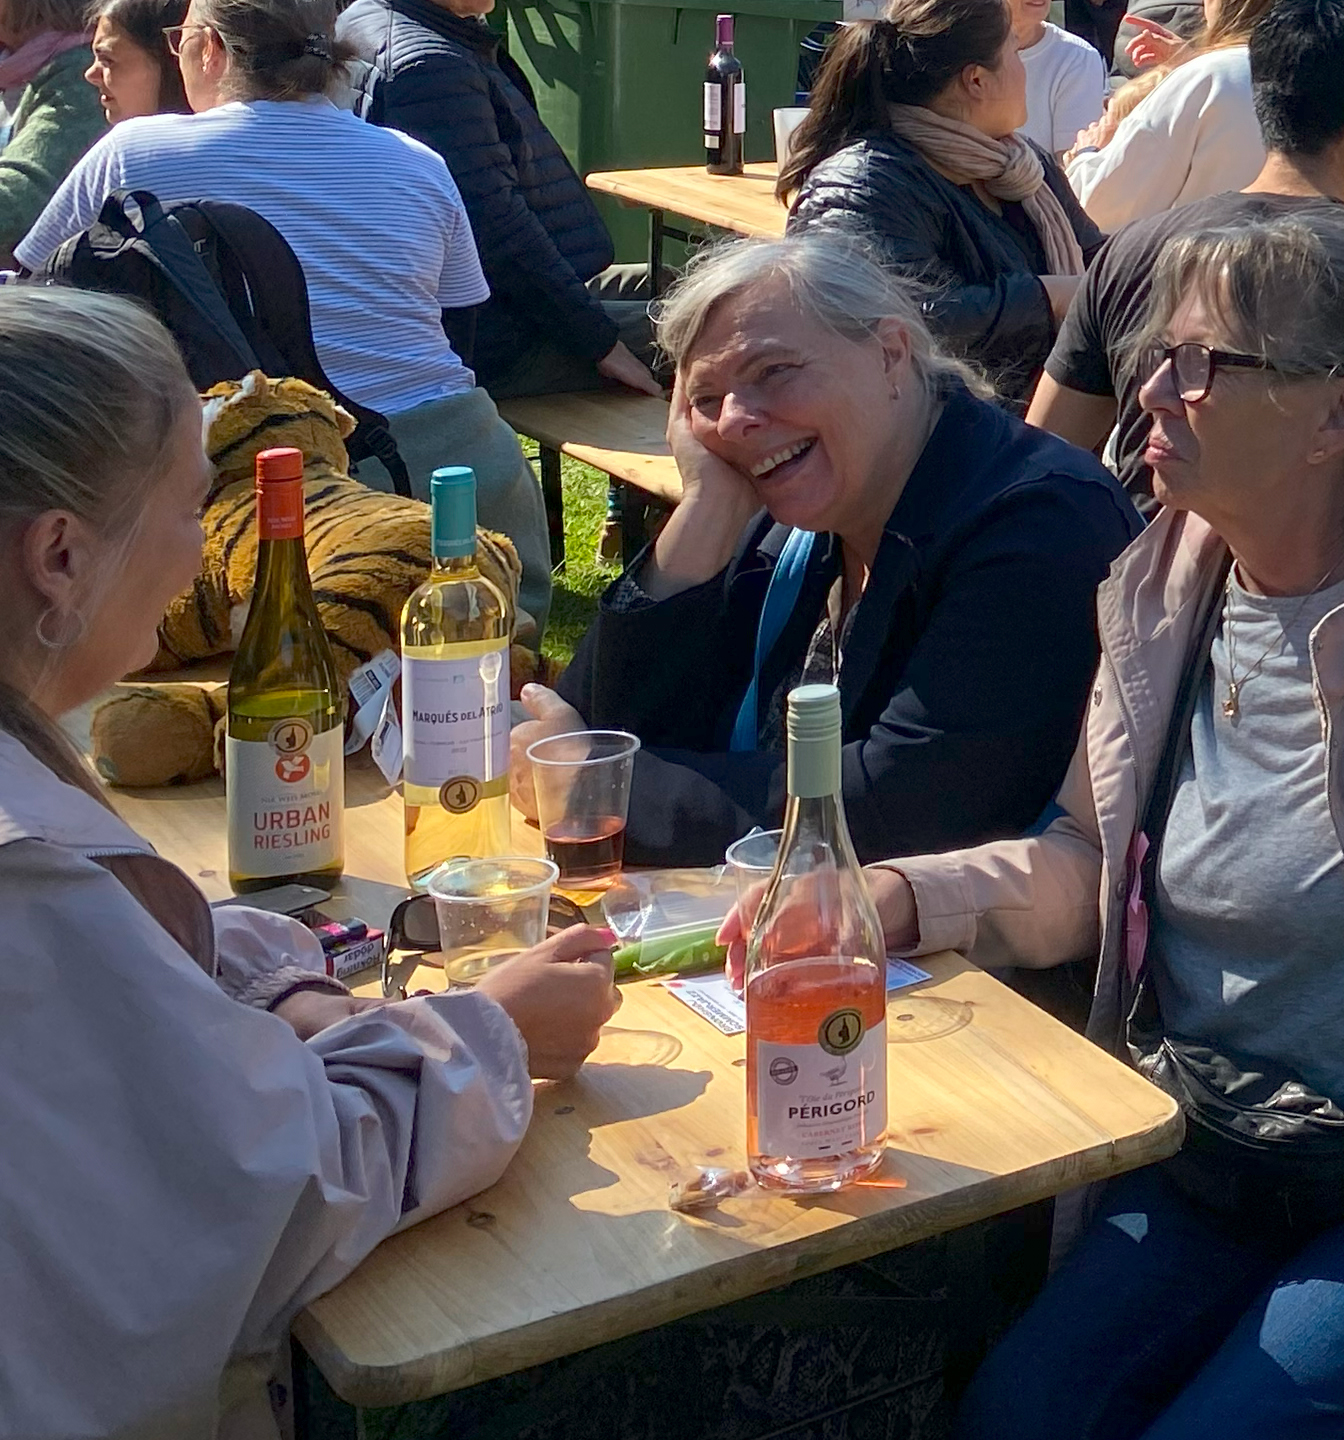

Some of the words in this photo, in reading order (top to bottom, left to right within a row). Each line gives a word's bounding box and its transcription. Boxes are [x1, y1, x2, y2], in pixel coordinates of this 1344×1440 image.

[413, 709, 458, 725] MARQUÉS
[460, 711, 477, 721] DEL
[478, 703, 504, 719] ATRIO
[254, 801, 330, 831] URBAN
[254, 824, 330, 849] RIESLING
[788, 1090, 876, 1120] PÉRIGORD
